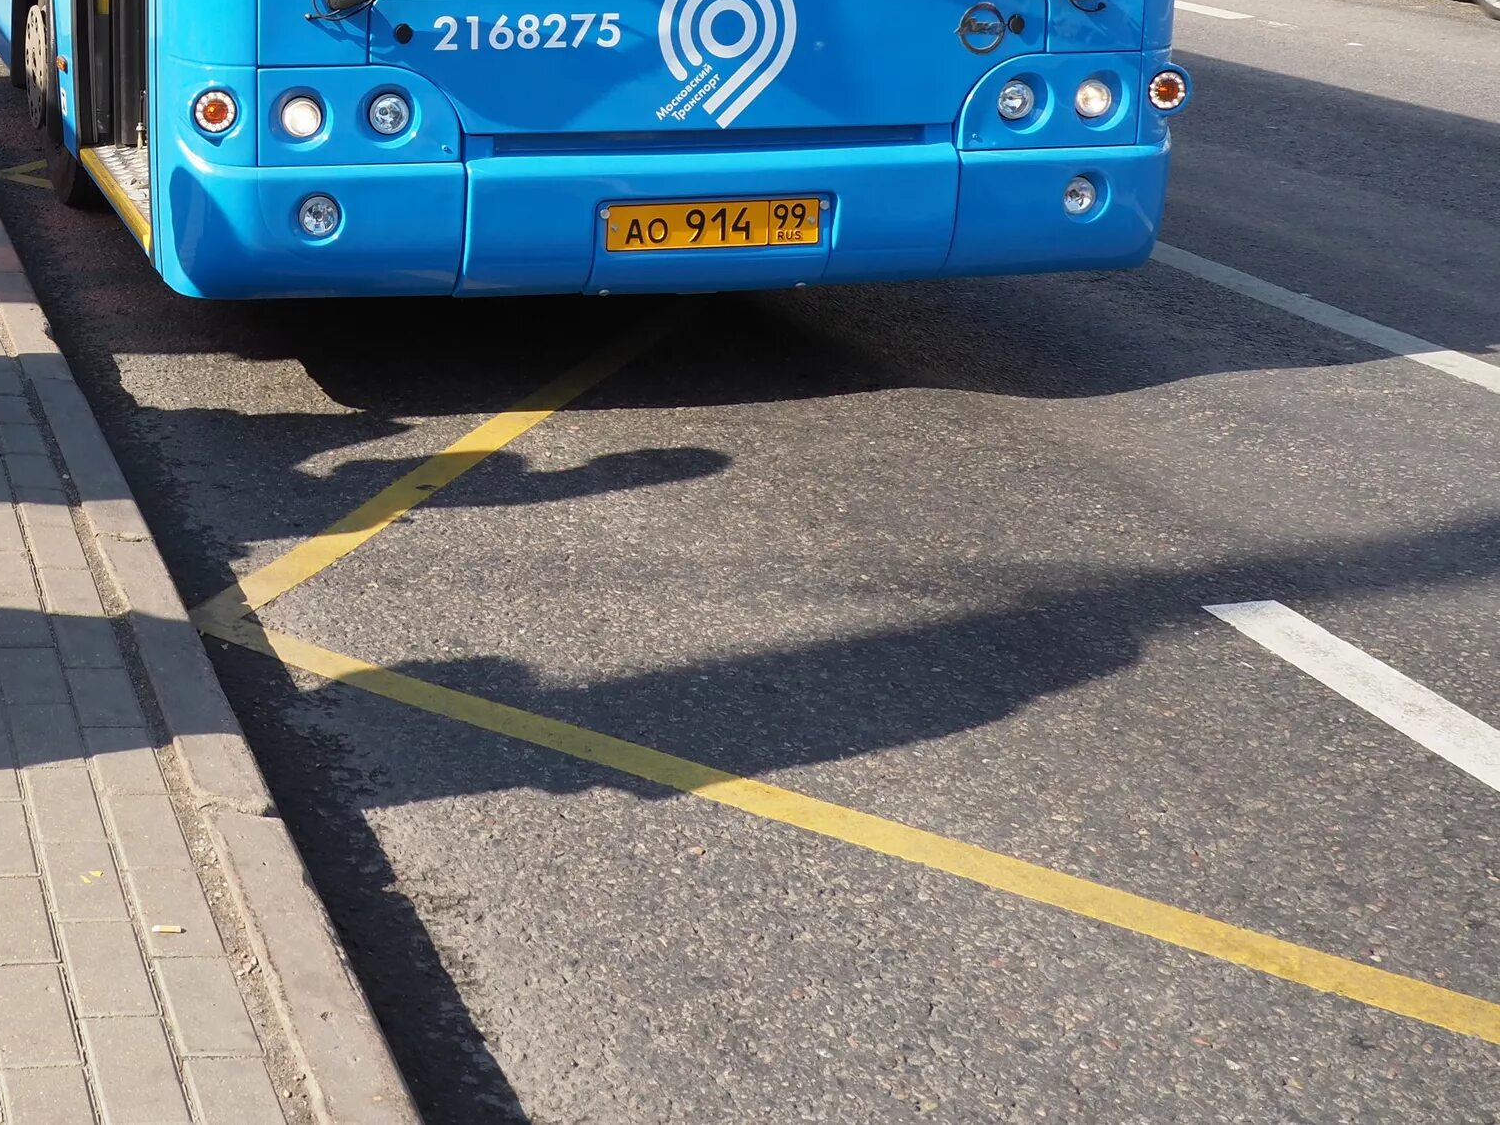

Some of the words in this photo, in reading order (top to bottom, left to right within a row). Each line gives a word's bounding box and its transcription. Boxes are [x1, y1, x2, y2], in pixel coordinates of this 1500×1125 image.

[433, 13, 621, 51] 2168275
[655, 63, 713, 121] Московский
[671, 73, 720, 121] Транспорт
[624, 218, 669, 245] АО
[685, 207, 751, 243] 914
[773, 203, 806, 229] 99
[777, 230, 802, 241] RUS
